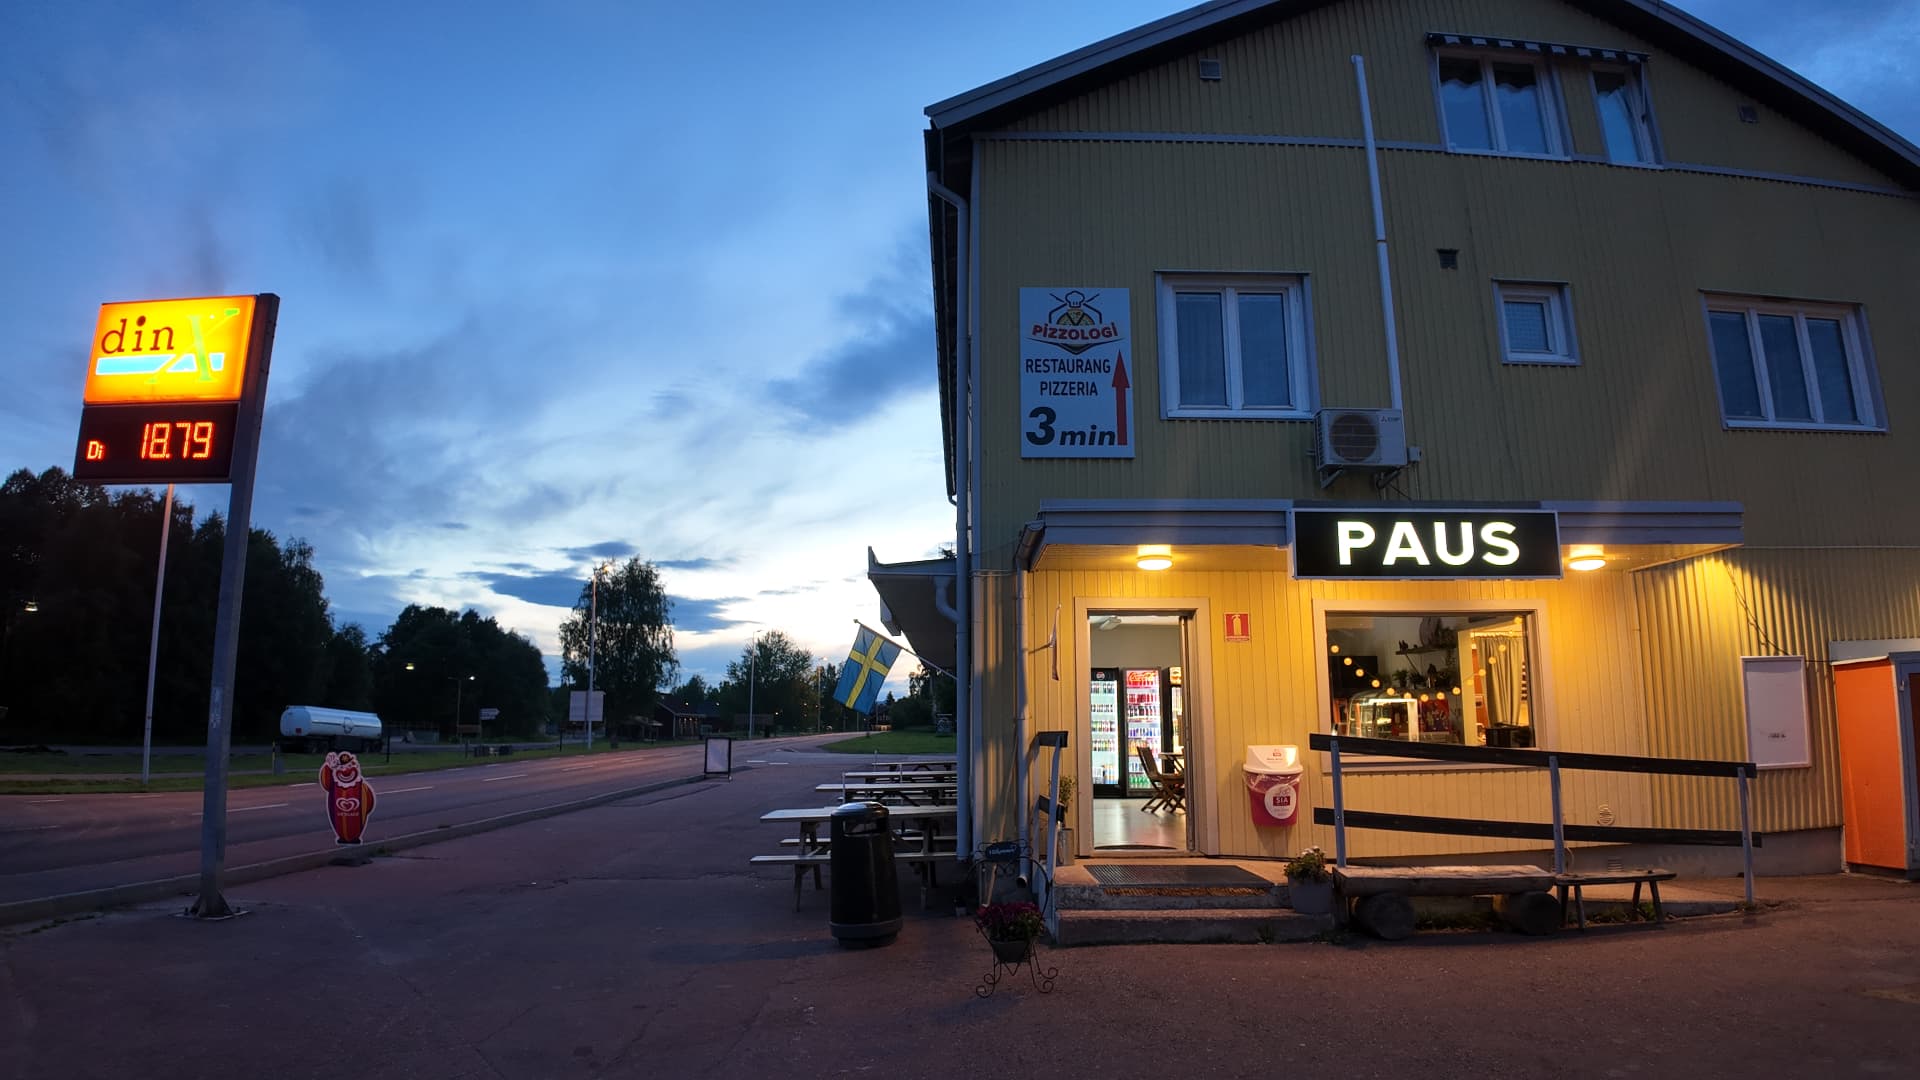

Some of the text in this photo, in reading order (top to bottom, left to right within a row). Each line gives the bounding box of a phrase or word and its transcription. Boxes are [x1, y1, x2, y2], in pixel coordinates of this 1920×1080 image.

[1025, 358, 1111, 373] RESTAURANG
[1040, 381, 1098, 396] PIZZERIA
[1025, 406, 1116, 446] 3 min
[86, 440, 104, 460] Di
[1337, 521, 1520, 566] PAUS
